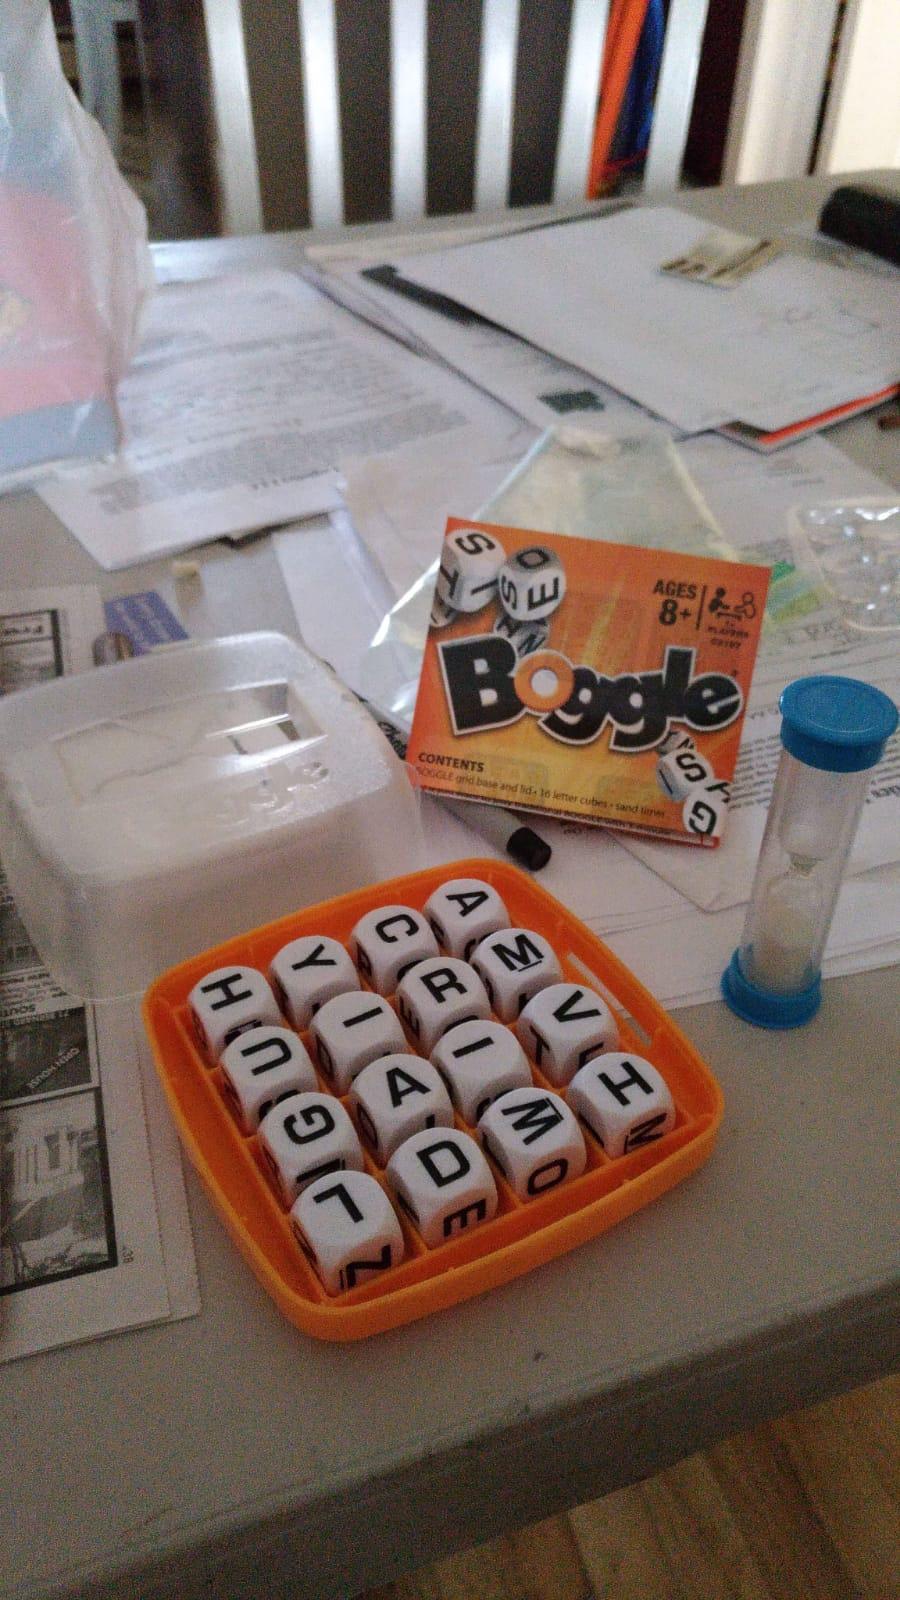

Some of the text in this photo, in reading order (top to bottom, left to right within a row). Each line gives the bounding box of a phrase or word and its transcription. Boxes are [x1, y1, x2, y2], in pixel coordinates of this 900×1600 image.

[455, 533, 496, 556] S
[502, 575, 518, 610] S
[528, 577, 559, 611] E
[653, 578, 697, 600] AGES
[659, 598, 691, 626] 8+
[438, 636, 743, 752] Boggle
[418, 752, 485, 772] CONTENTS
[676, 753, 707, 782] S
[477, 776, 498, 787] base
[500, 783, 519, 793] and
[552, 788, 578, 802] letter
[580, 796, 607, 810] cubes
[616, 801, 640, 814] sand
[689, 801, 717, 836] G
[446, 890, 489, 917] A
[375, 913, 419, 943] C
[291, 943, 337, 971] Y
[491, 933, 544, 972] M
[201, 973, 253, 1011] H
[420, 967, 468, 1004] R
[342, 1006, 383, 1028] I
[552, 989, 602, 1023] V
[241, 1037, 292, 1076] U
[452, 1036, 495, 1059] I
[386, 1067, 432, 1108] A
[597, 1061, 654, 1106] H
[283, 1104, 335, 1145] G
[416, 1140, 471, 1188] D
[312, 1183, 364, 1224] L
[443, 1198, 486, 1237] E
